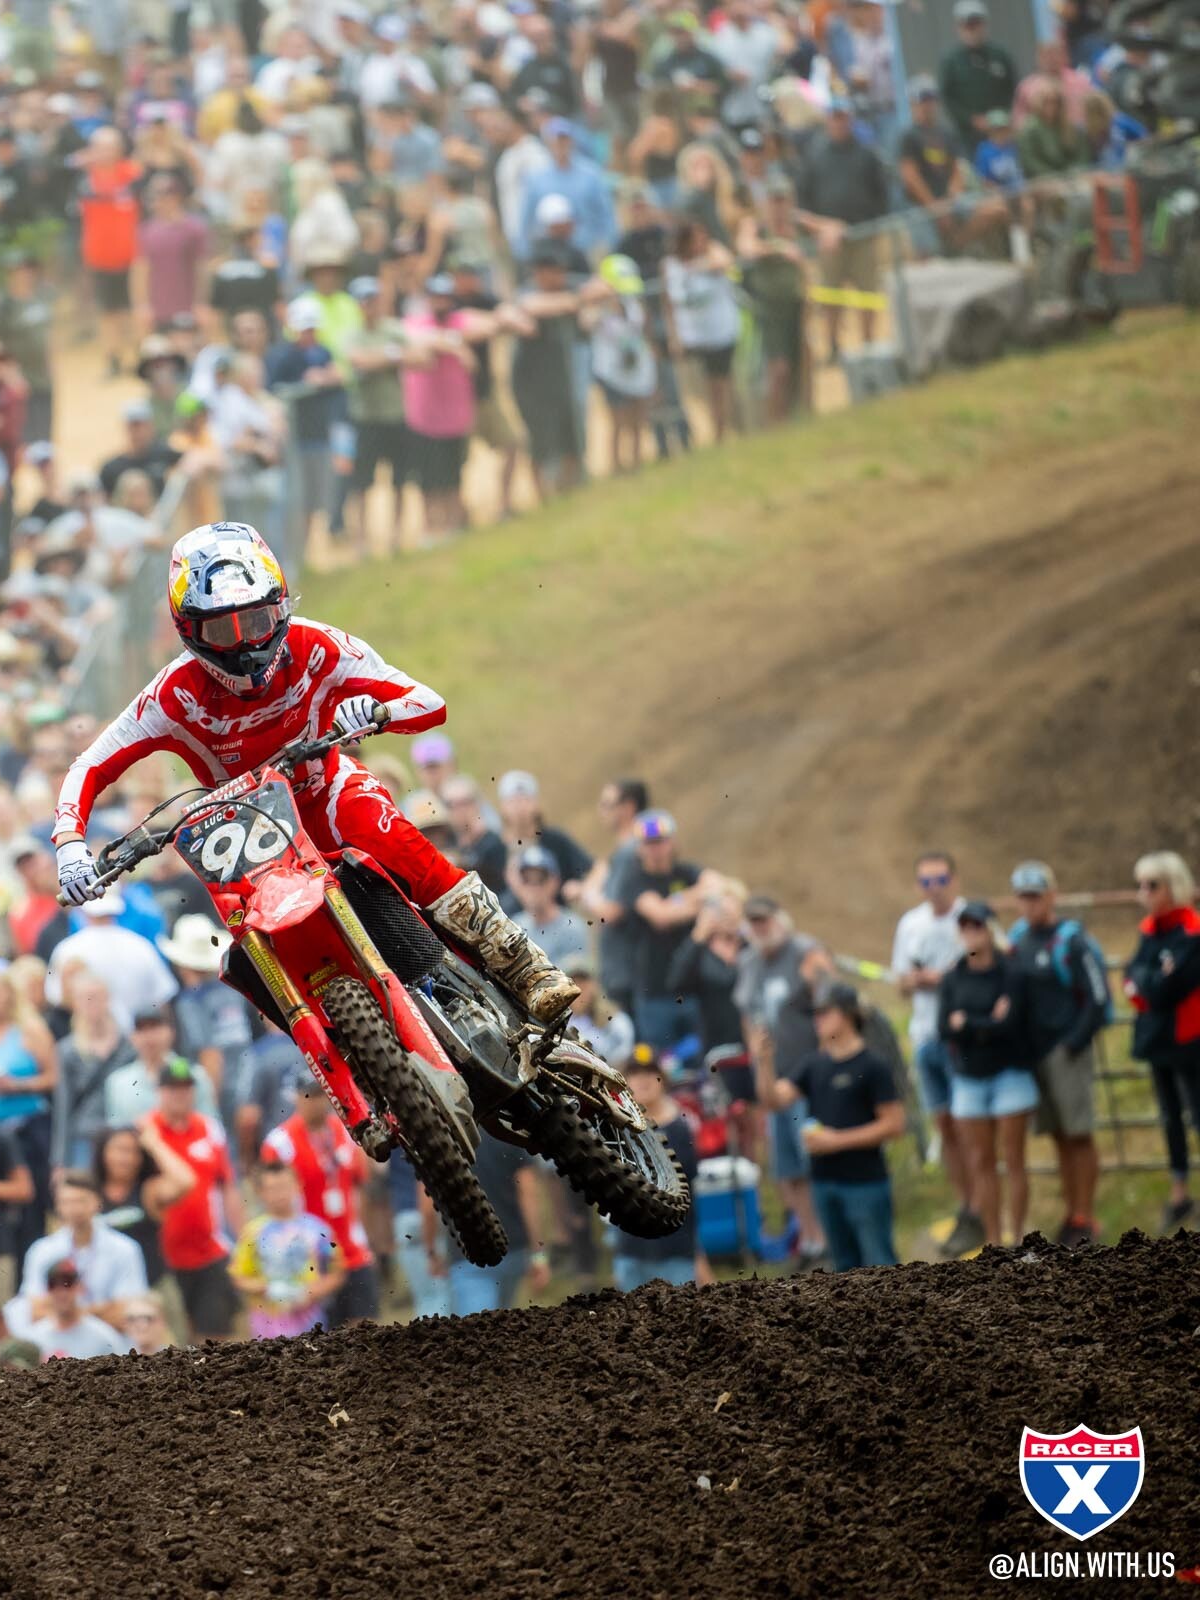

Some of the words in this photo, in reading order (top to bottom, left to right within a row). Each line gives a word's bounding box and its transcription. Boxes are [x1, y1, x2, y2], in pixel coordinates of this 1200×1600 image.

[173, 643, 326, 736] alpinestars
[202, 803, 293, 884] 96
[204, 806, 234, 829] LUC
